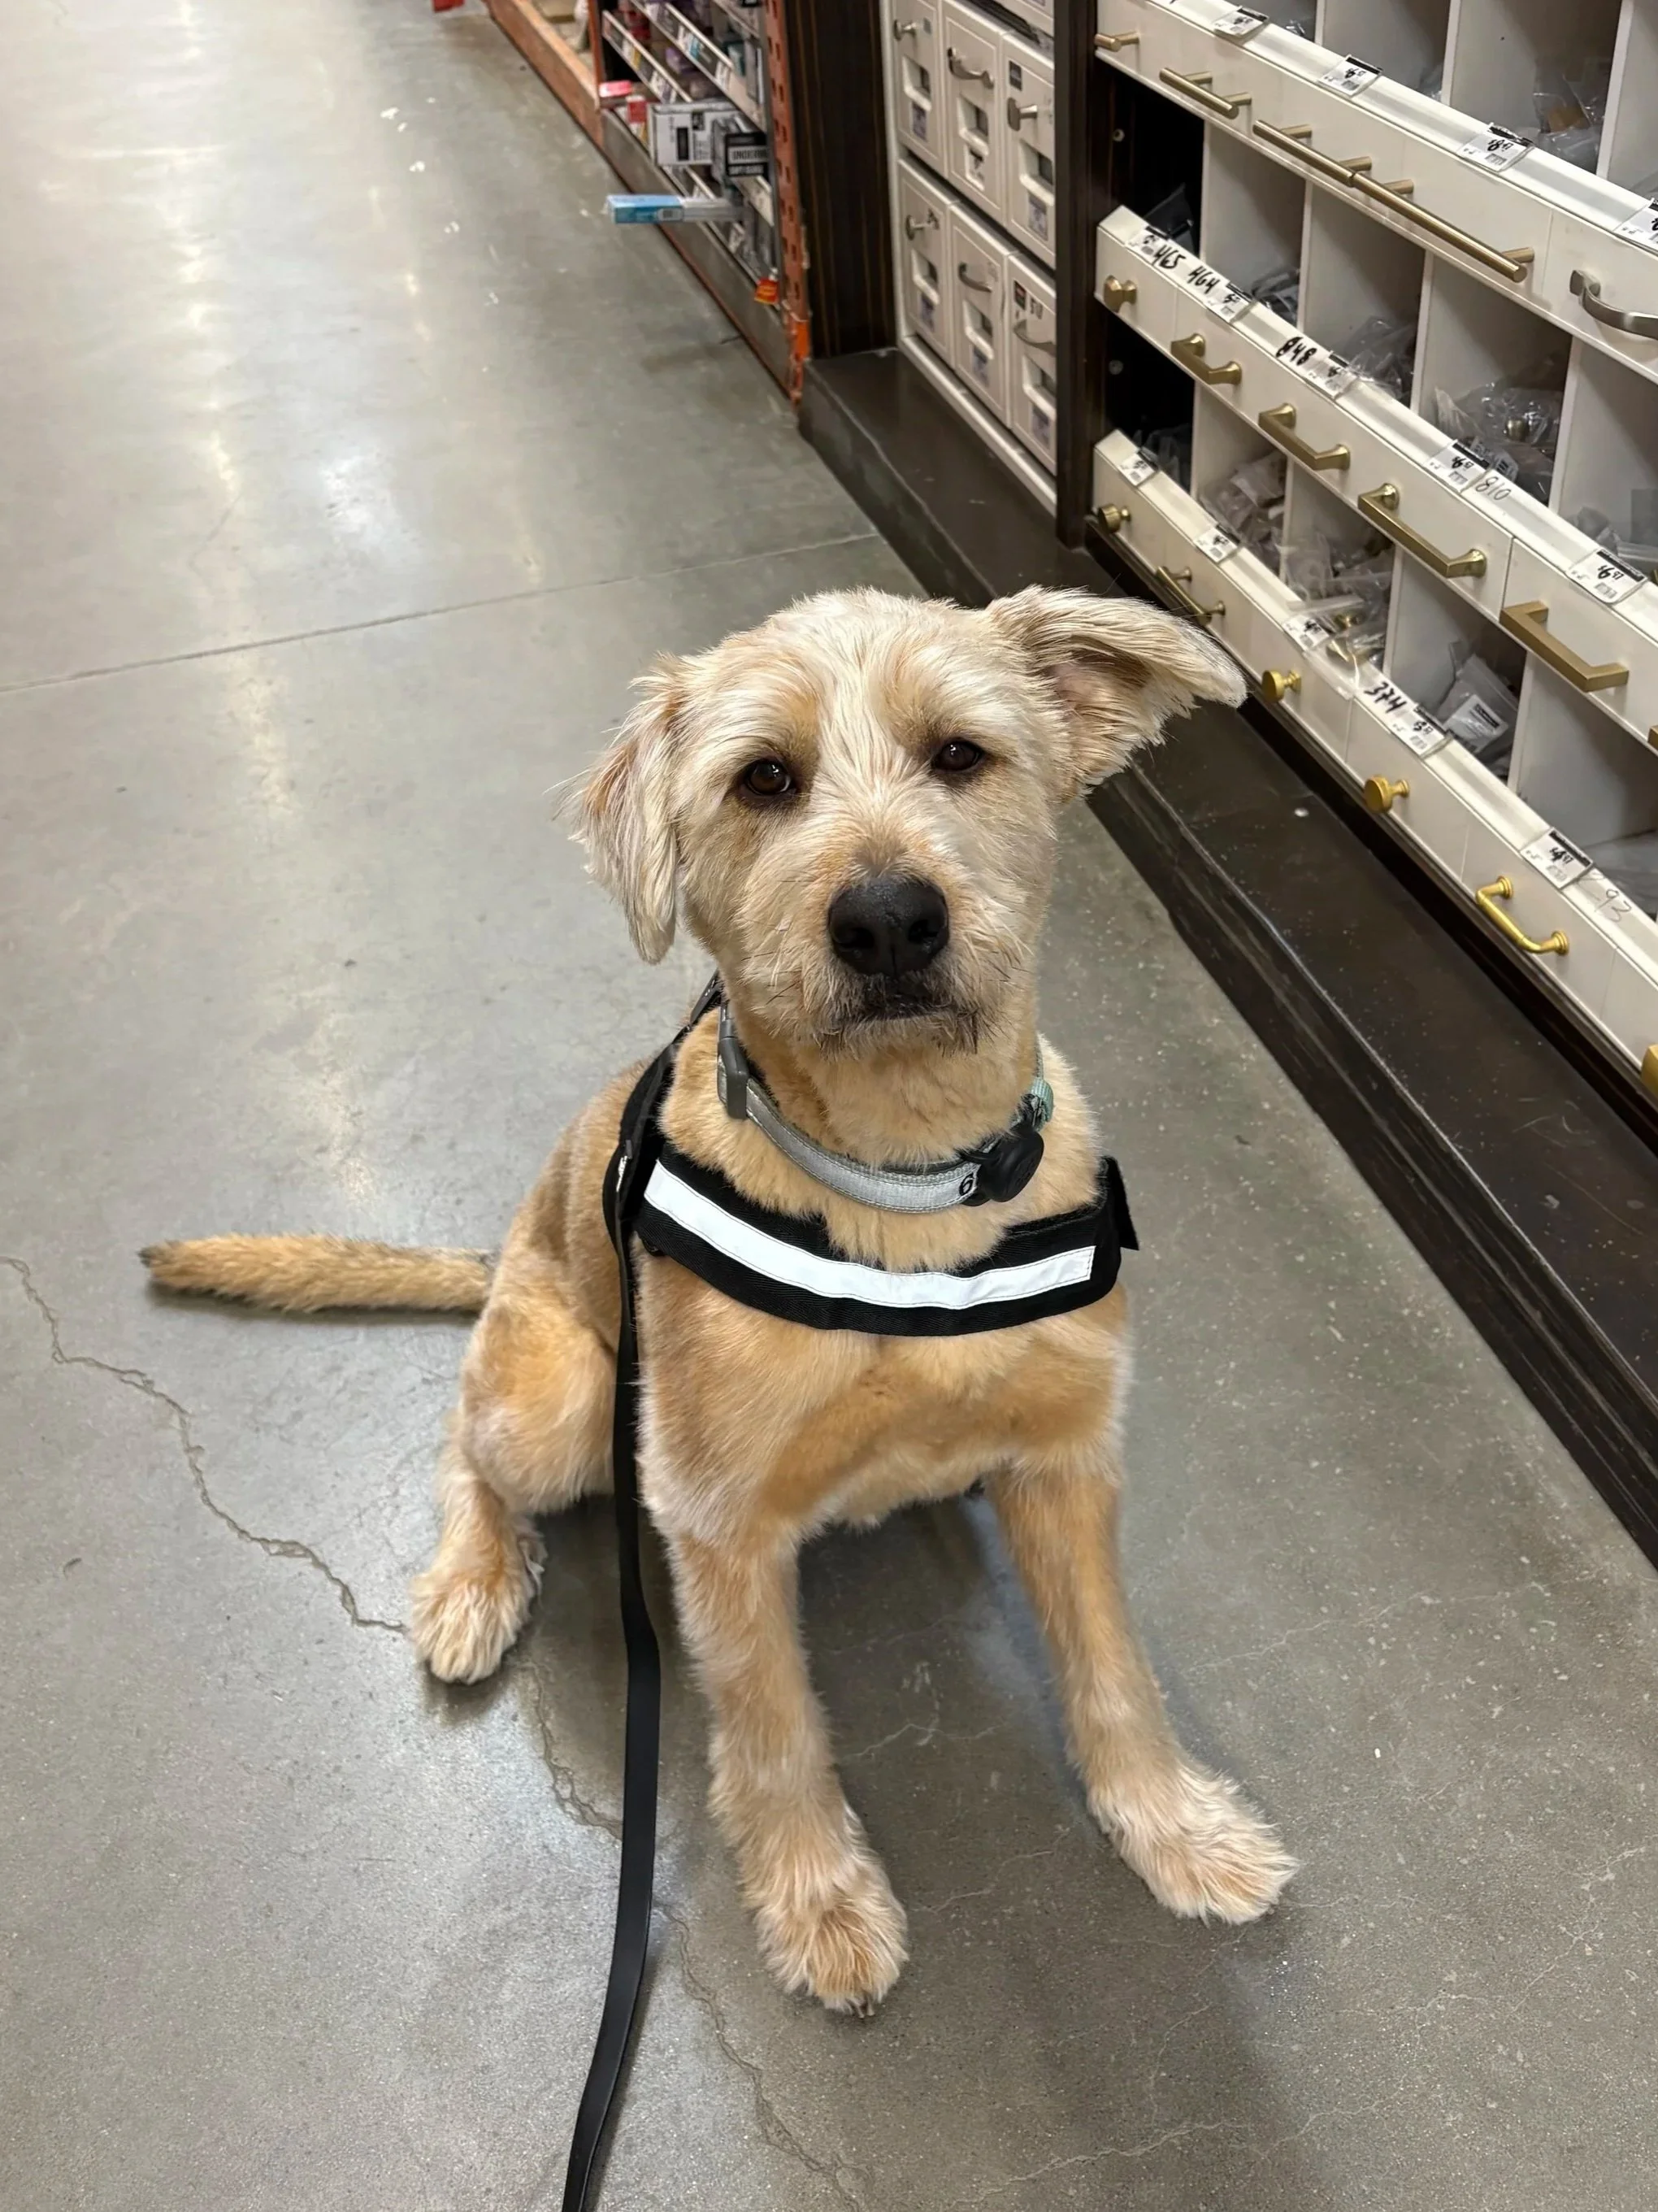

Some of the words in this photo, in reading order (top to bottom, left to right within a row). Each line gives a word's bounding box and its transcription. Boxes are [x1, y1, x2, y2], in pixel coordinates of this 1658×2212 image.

[1152, 244, 1187, 269] 465
[1187, 264, 1221, 294] 464
[1474, 476, 1512, 501] 810
[1363, 681, 1408, 714] 374
